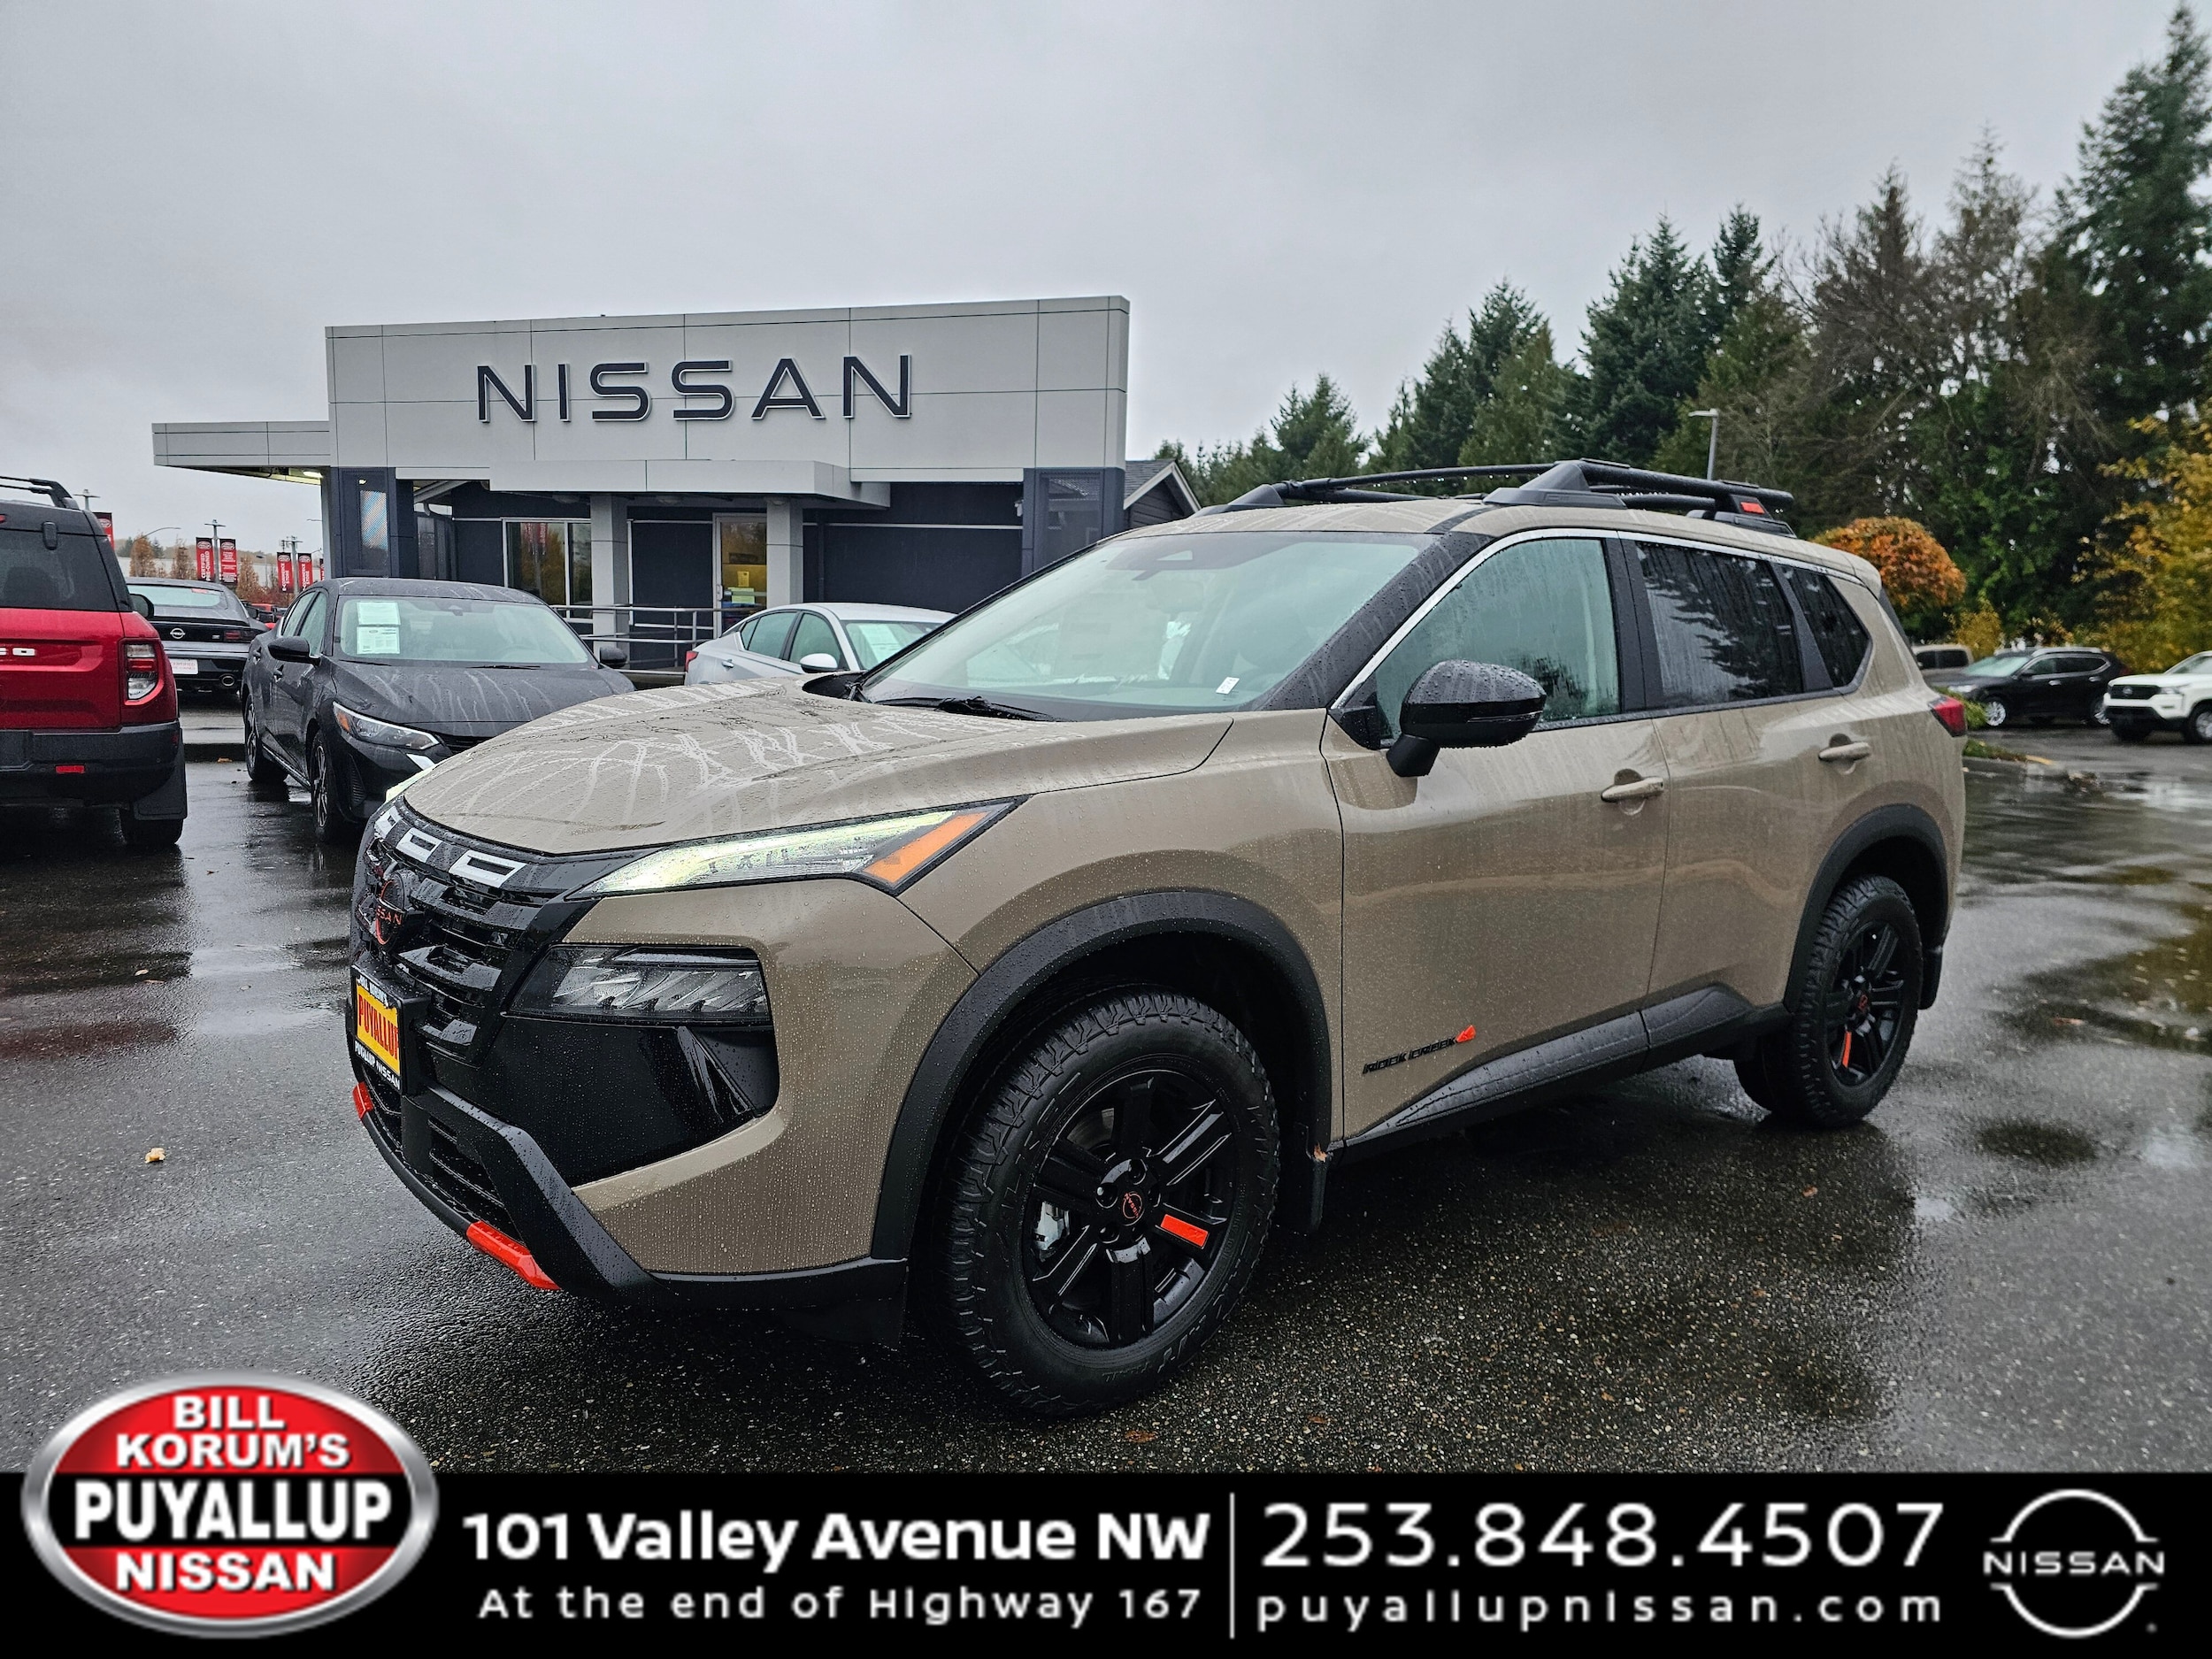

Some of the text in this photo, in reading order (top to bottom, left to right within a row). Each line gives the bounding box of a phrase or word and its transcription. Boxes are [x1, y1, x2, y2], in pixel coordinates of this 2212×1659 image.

[477, 354, 912, 423] NISSAN
[358, 994, 399, 1061] PUYALLUP
[375, 1060, 401, 1091] NISSAN
